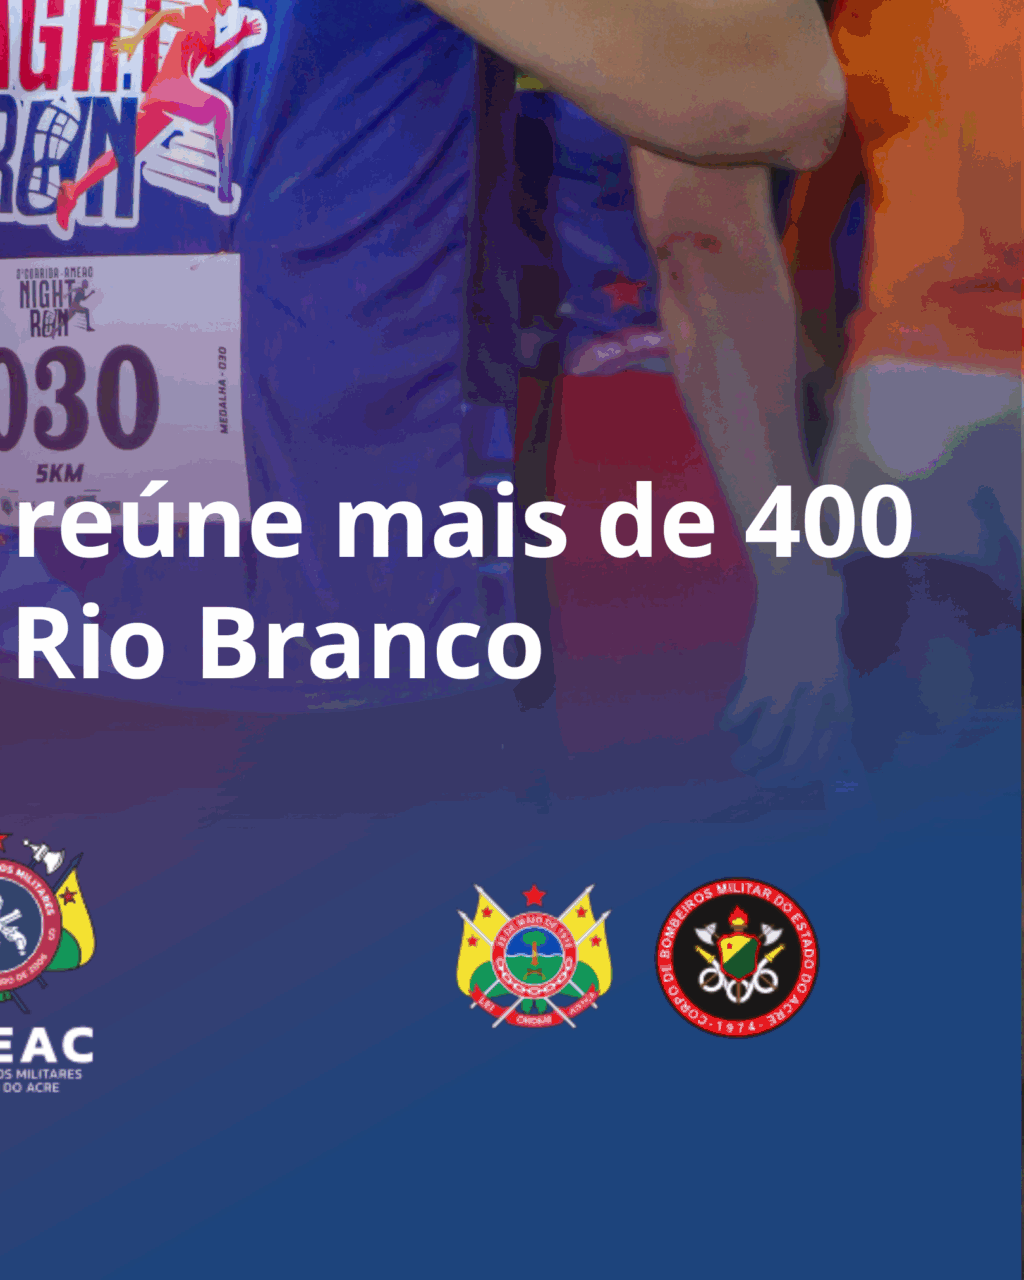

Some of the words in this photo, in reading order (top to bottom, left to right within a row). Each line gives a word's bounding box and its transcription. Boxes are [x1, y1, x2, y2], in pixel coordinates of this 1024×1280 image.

[19, 279, 76, 308] NIGHT
[30, 308, 69, 337] RUN
[218, 346, 227, 370] 030
[218, 379, 228, 434] MEDALHA
[35, 463, 84, 483] 5KM
